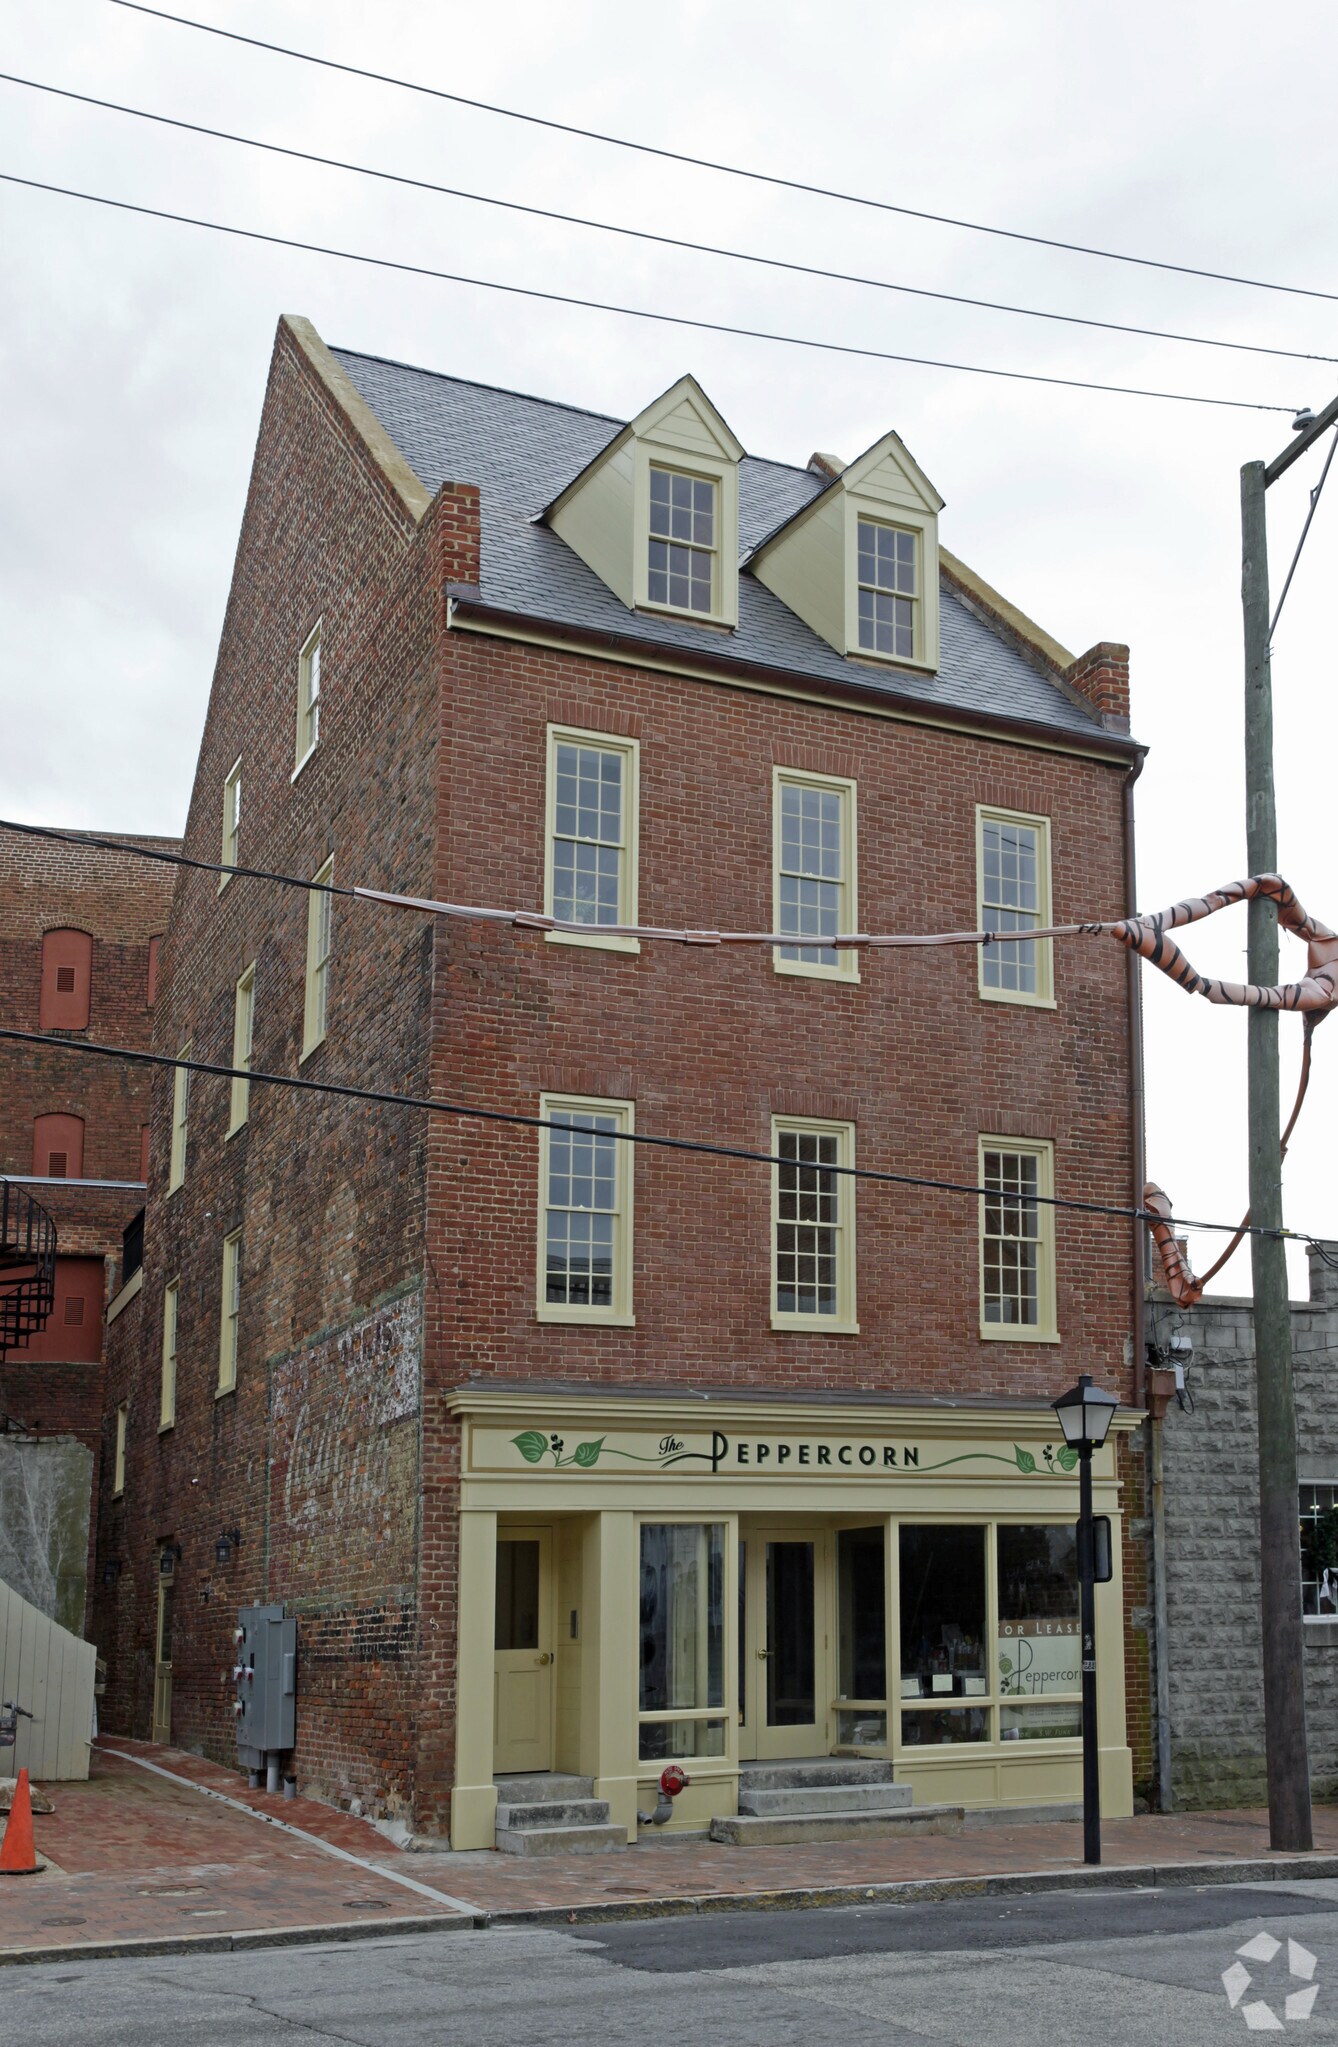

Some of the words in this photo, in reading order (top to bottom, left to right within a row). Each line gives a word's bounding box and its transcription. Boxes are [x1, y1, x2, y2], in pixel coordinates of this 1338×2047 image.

[658, 1434, 685, 1455] The
[998, 1623, 1025, 1636] OR
[1036, 1622, 1081, 1634] LEASE
[1007, 1639, 1081, 1694] Peppercor
